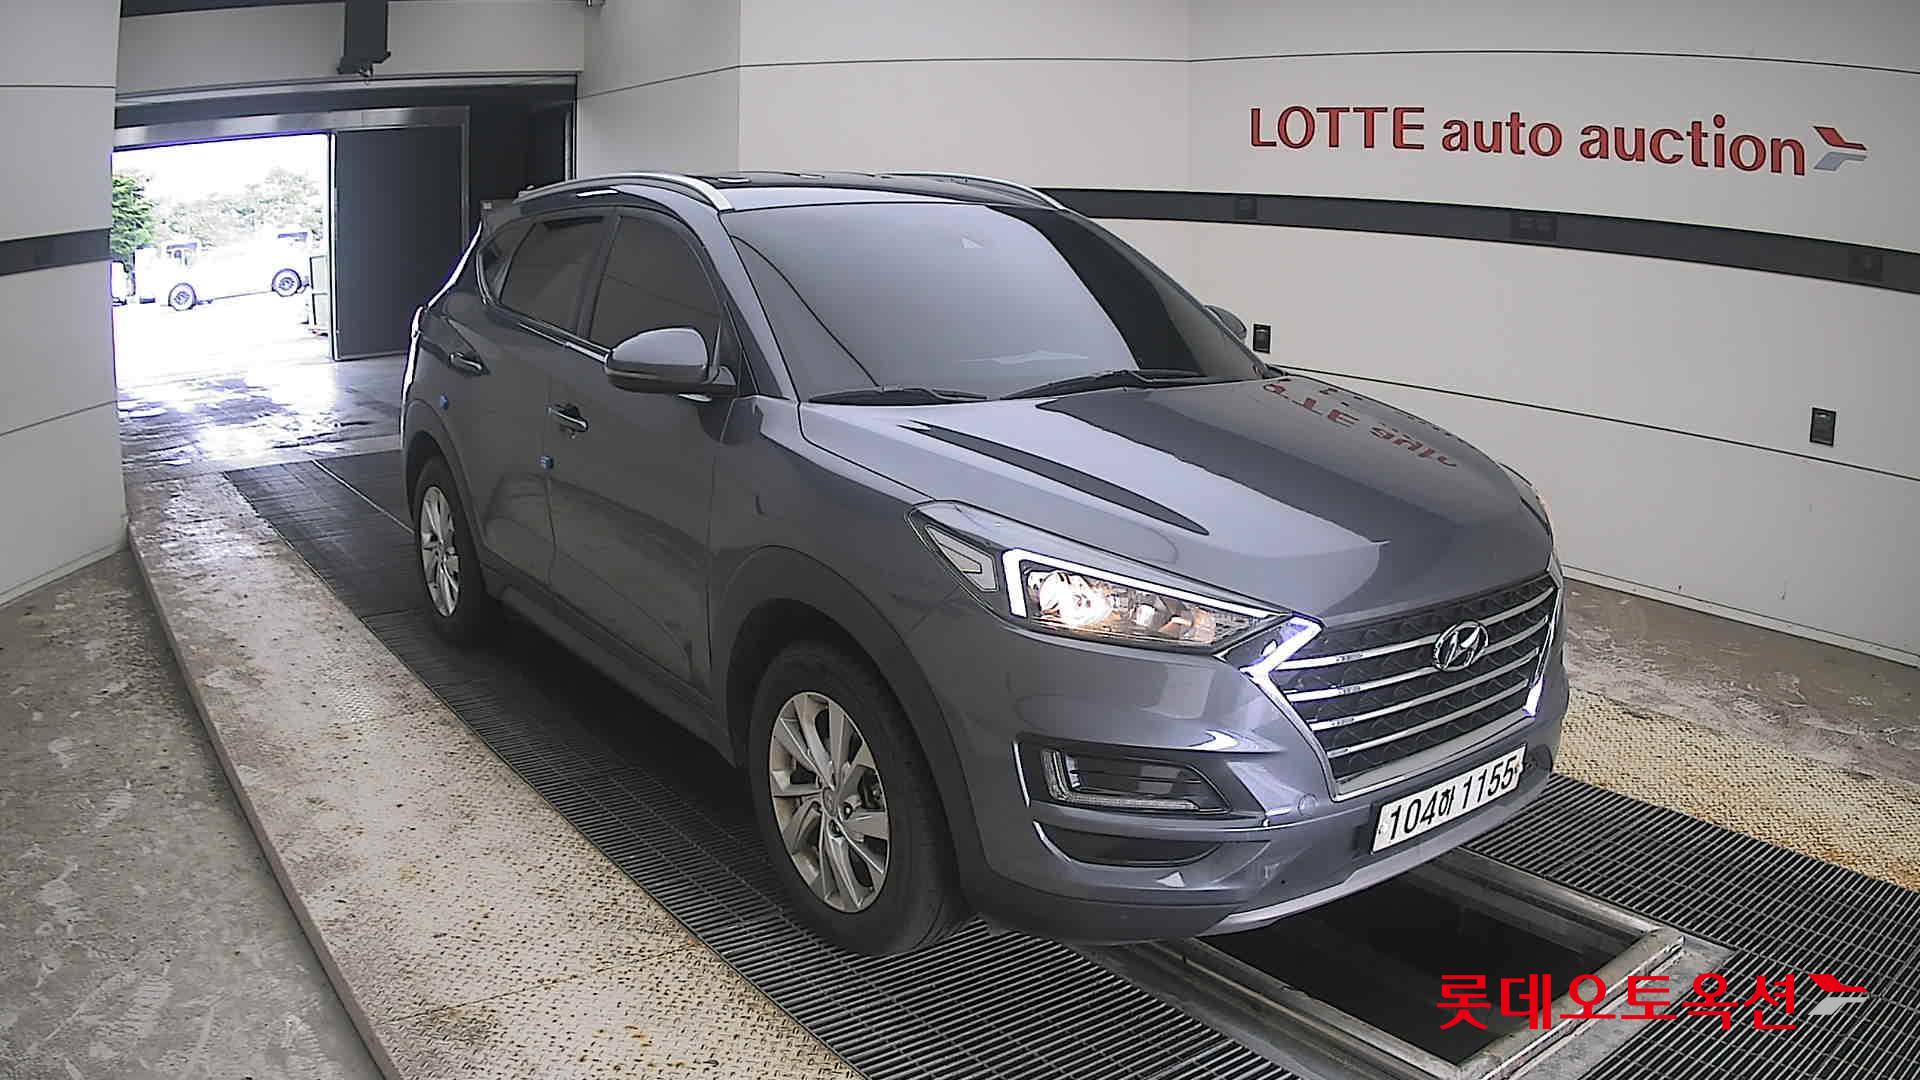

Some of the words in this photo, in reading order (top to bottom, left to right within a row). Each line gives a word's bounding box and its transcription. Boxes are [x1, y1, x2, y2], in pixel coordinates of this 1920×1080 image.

[1251, 106, 1425, 150] LOTTE
[1441, 112, 1562, 156] auto
[1579, 114, 1805, 176] auction
[1390, 784, 1456, 841] 104하
[1462, 754, 1518, 810] 1155
